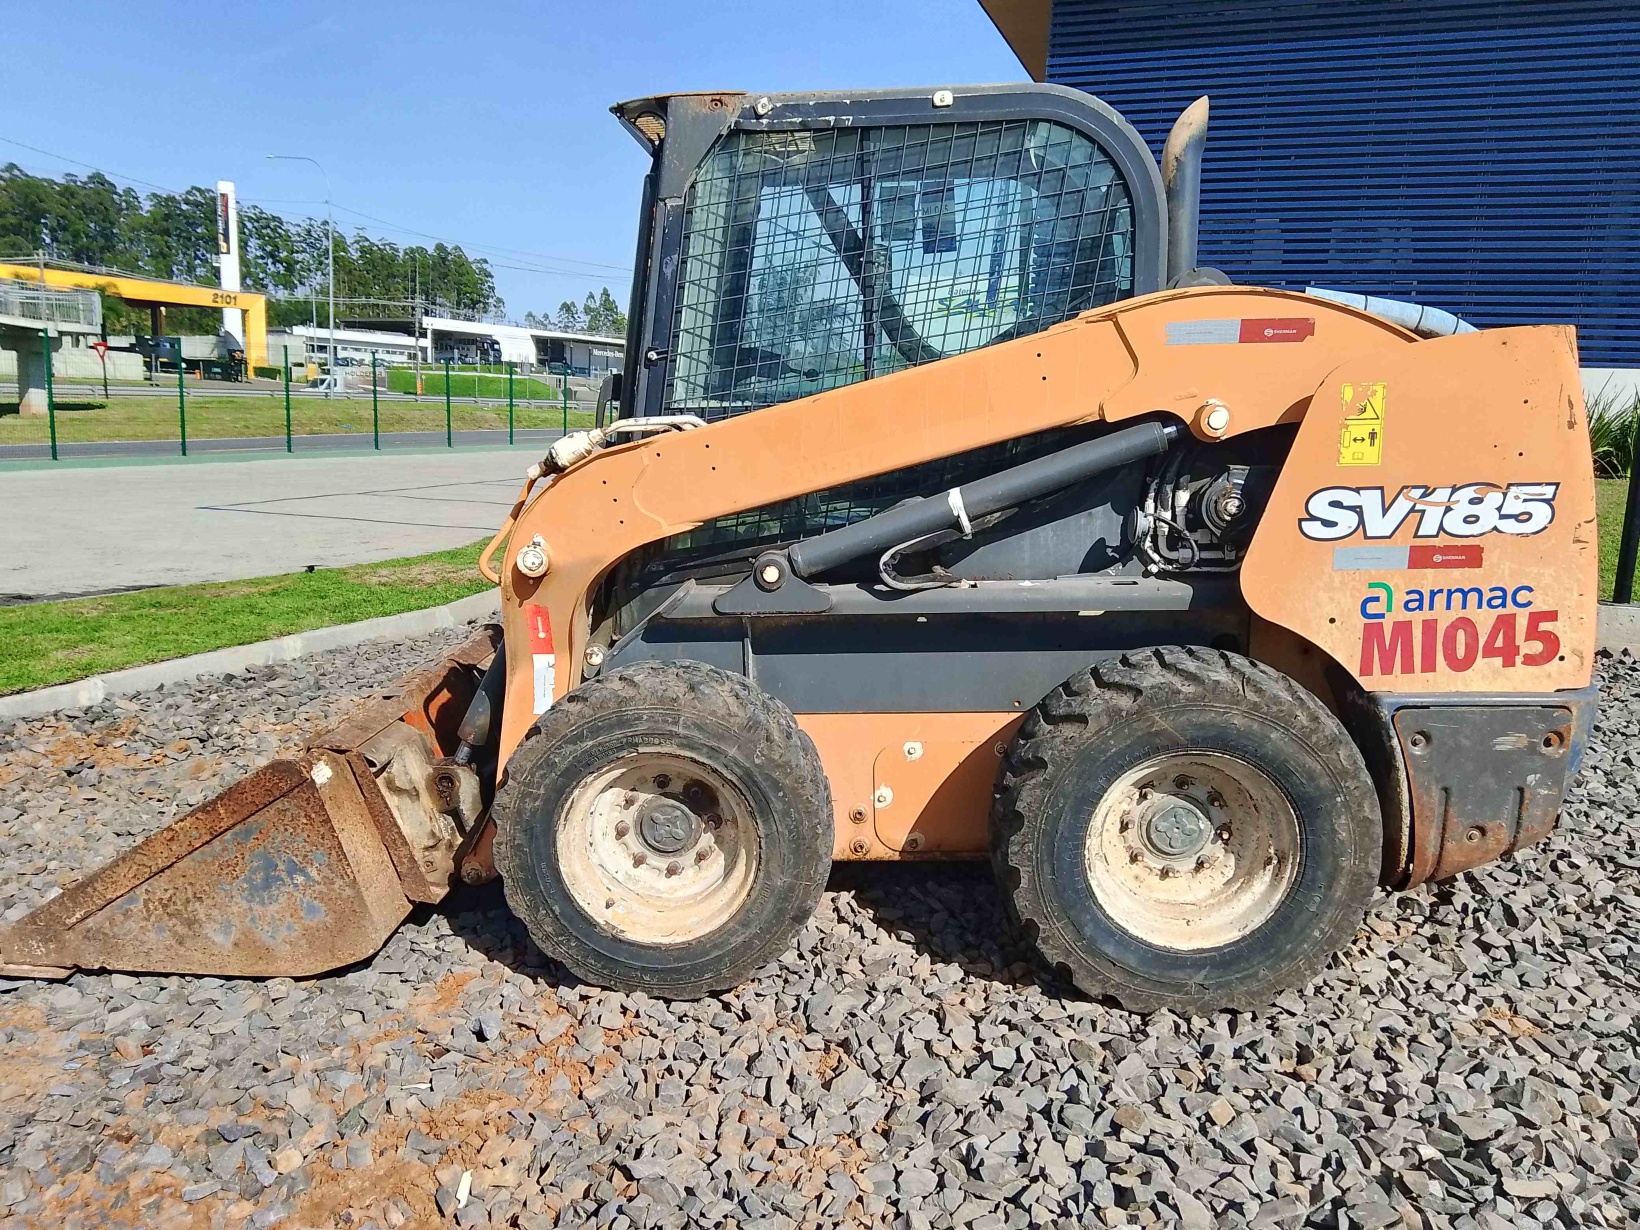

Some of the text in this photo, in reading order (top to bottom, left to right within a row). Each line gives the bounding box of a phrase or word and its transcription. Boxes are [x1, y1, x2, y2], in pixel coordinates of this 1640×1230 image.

[212, 292, 238, 306] 2101
[948, 287, 981, 296] Bateras
[593, 348, 624, 358] Mercedes-Ben
[1297, 481, 1561, 541] SV185
[1403, 585, 1535, 612] armac
[1359, 609, 1561, 677] MI045
